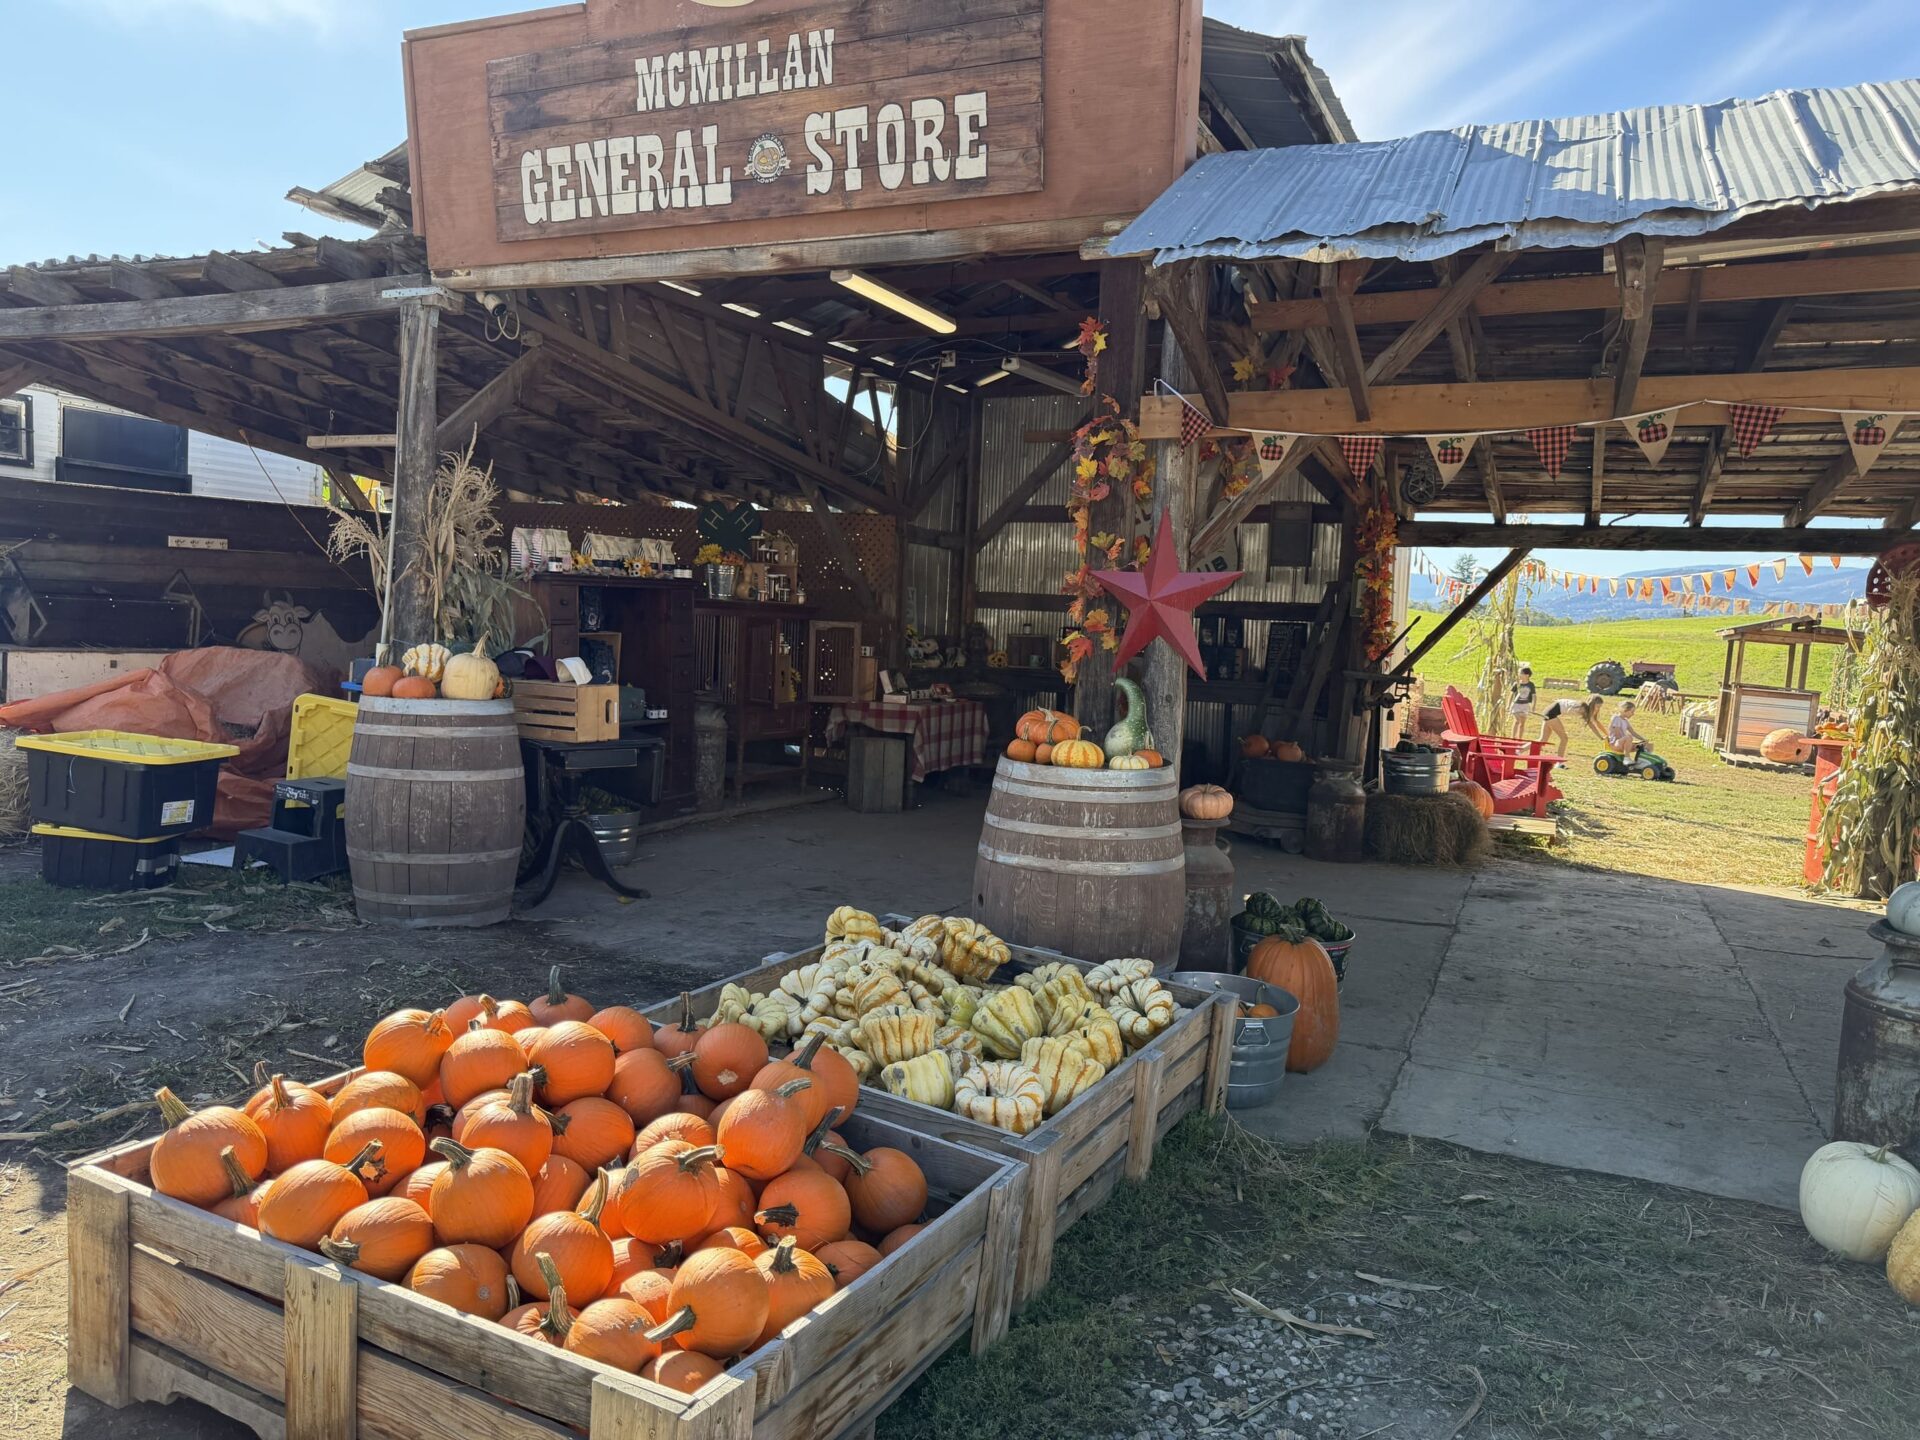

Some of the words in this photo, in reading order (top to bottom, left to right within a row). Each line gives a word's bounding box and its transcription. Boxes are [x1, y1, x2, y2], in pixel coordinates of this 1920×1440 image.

[635, 28, 835, 112] MCMILLAN
[520, 124, 732, 224] GENERAL
[804, 91, 989, 195] STORE
[770, 134, 786, 157] FARMS
